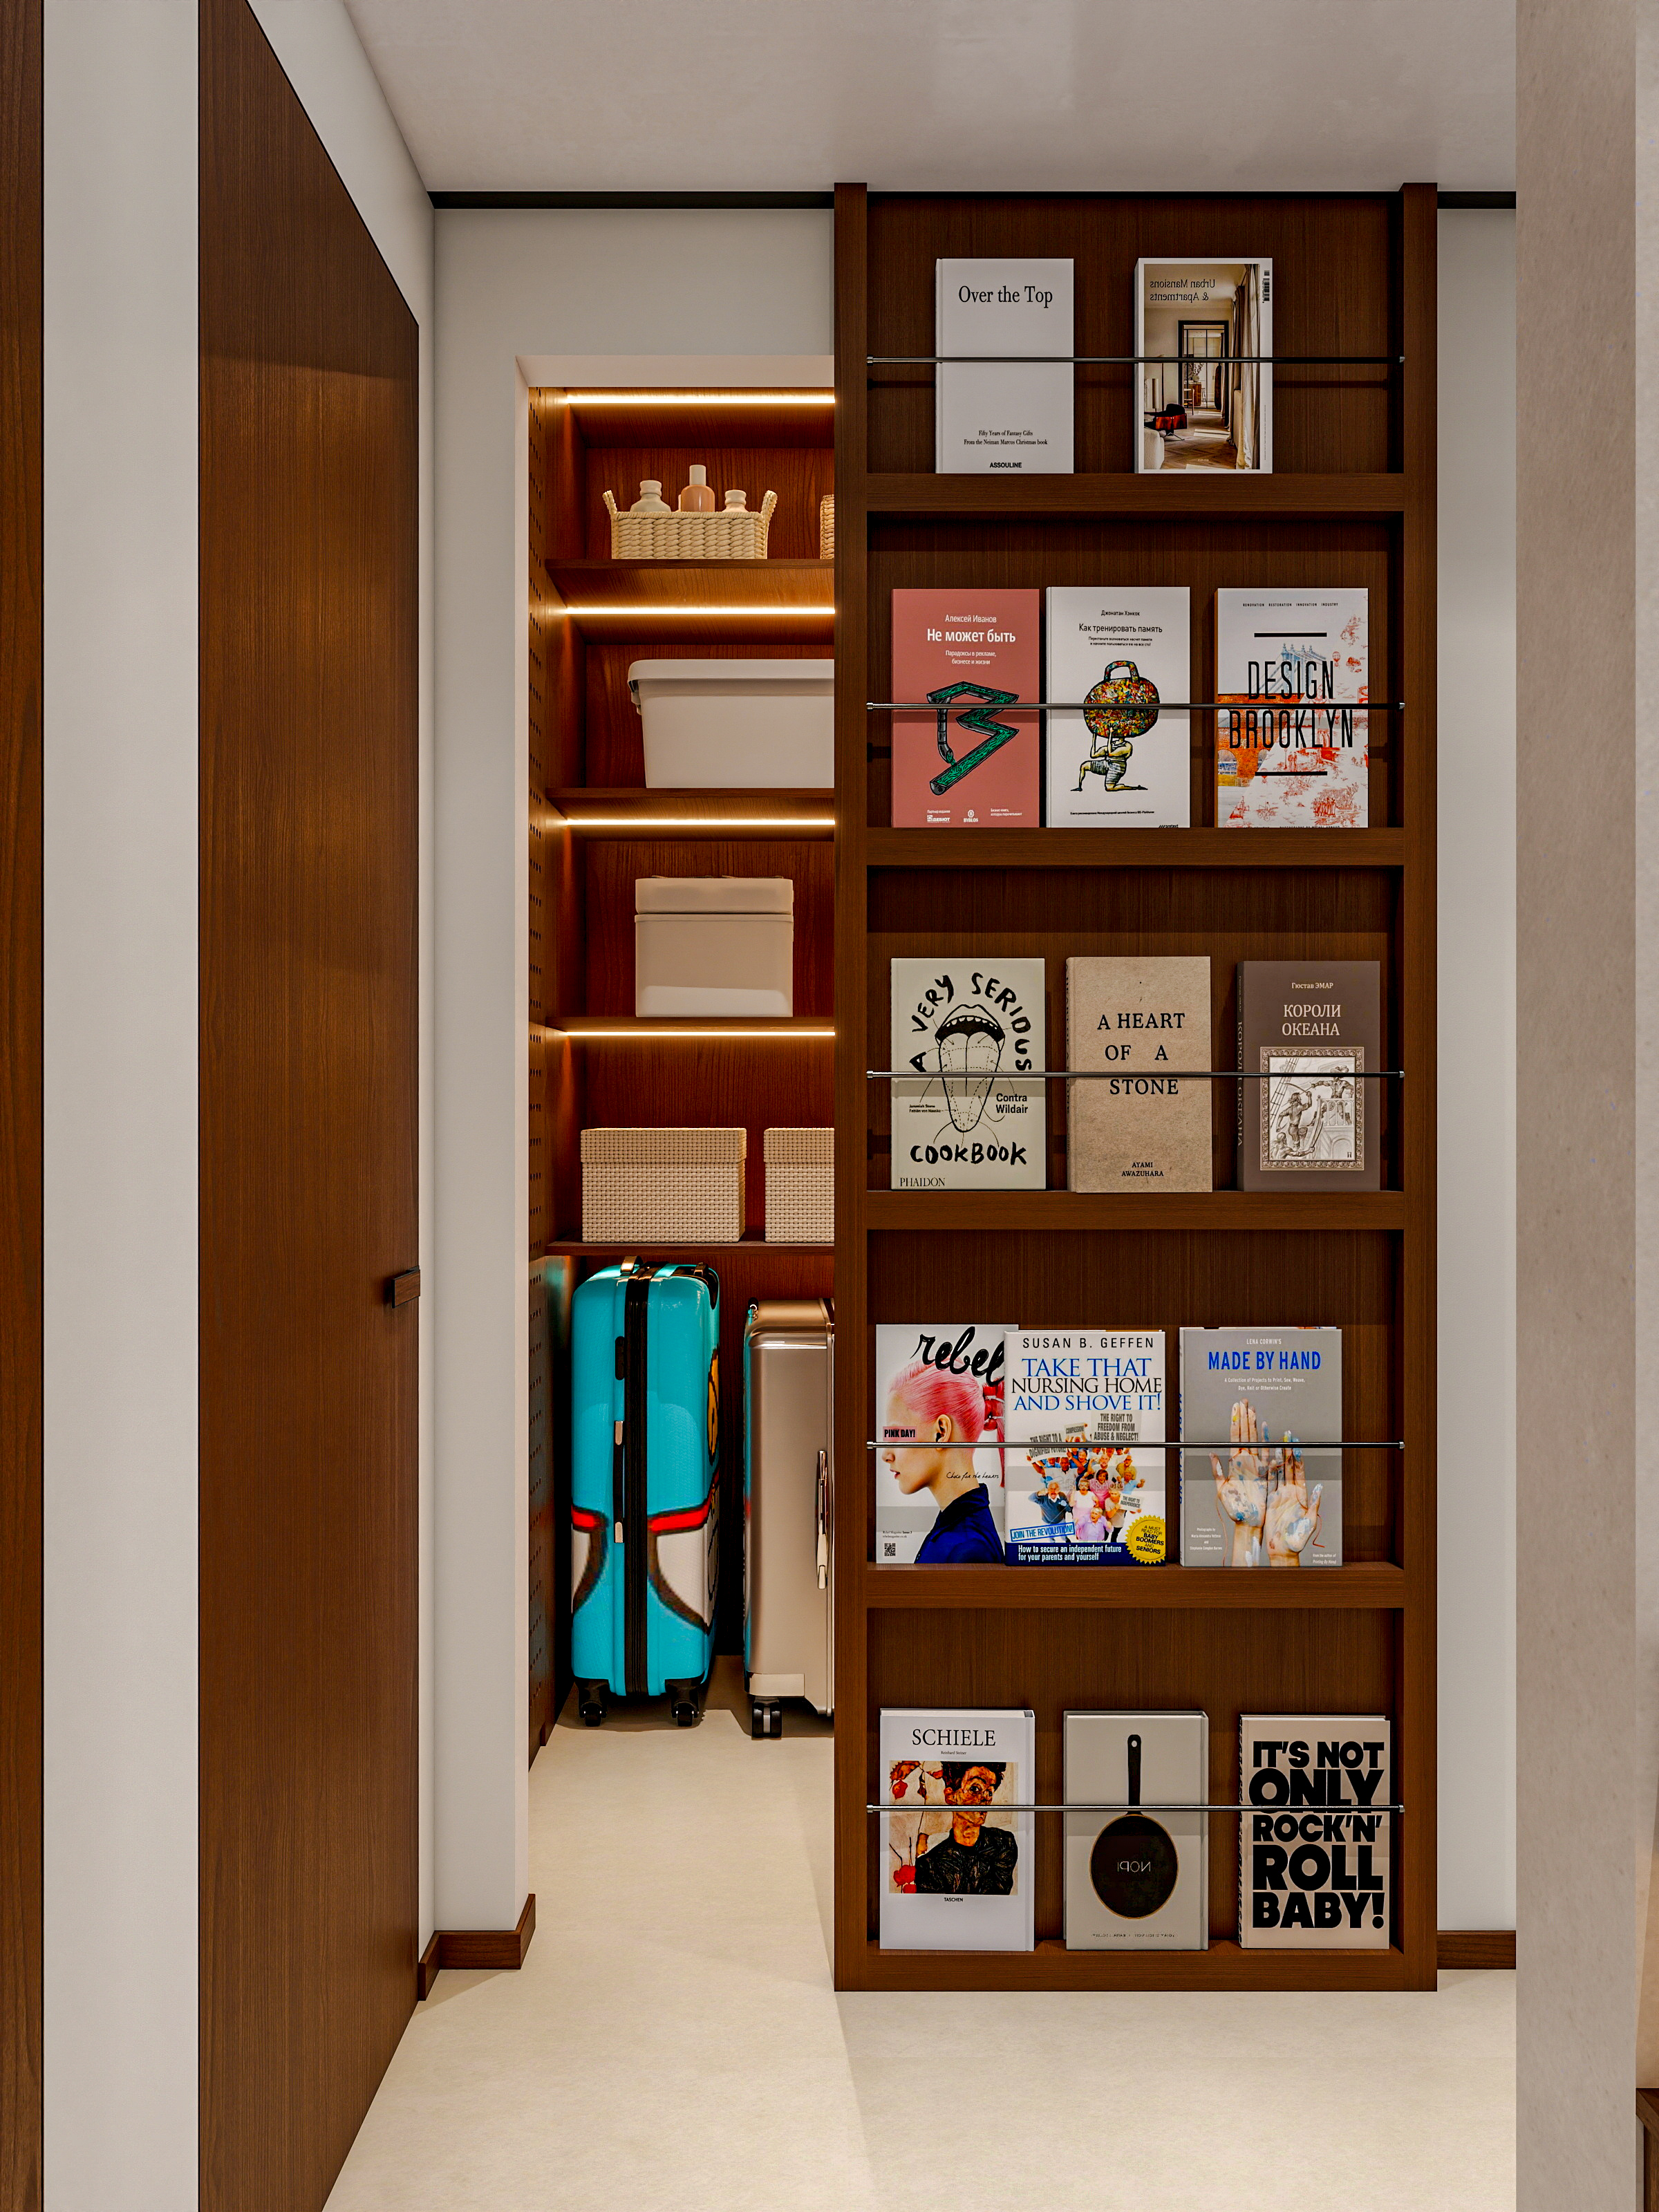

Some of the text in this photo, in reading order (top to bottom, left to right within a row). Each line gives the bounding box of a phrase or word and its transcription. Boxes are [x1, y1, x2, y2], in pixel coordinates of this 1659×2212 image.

[959, 285, 1053, 308] Over the Top
[945, 614, 997, 623] Алексей Иванов
[927, 628, 1015, 642] Не может быть
[1079, 624, 1091, 632] Как
[1248, 661, 1333, 700] DESIGN
[1229, 710, 1353, 748] BROOKLYN
[1284, 1004, 1341, 1018] КОРОЛИ
[909, 973, 1032, 1072] A VERY SERIOUS
[1097, 1013, 1185, 1030] A HEART
[1282, 1022, 1340, 1036] ОКЕАНА
[1105, 1044, 1169, 1060] OF A
[1109, 1079, 1179, 1095] STONE
[996, 1093, 1027, 1102] Contra
[996, 1105, 1029, 1114] Wildair
[910, 1141, 1027, 1165] COOKBOOK
[900, 1177, 945, 1187] PHAIDON
[1022, 1338, 1154, 1348] SUSAN B. GEFFEN
[910, 1326, 1004, 1387] rebel
[1208, 1351, 1321, 1369] MADE BY HAND
[1021, 1358, 1152, 1377] TAKE THAT
[1011, 1378, 1162, 1394] NURSING HOME
[1013, 1393, 1161, 1411] AND SHOVE IT!
[1100, 1414, 1133, 1422] THE RIGHT TO
[884, 1429, 915, 1438] PINK DAY!
[1098, 1423, 1135, 1432] FREEDOM FROM
[1039, 1434, 1052, 1442] RIGHT
[1052, 1434, 1058, 1442] TO
[1058, 1433, 1062, 1442] A
[1094, 1432, 1138, 1441] ABUSE & NEGLECT!
[1012, 1524, 1074, 1539] JOIN THE REVOLUTION!
[1136, 1537, 1164, 1546] BOOMERS
[1069, 1545, 1103, 1555] independent
[1136, 1546, 1161, 1554] SENIORS
[1076, 1554, 1099, 1562] yourself
[912, 1729, 996, 1746] SCHIELE
[1253, 1741, 1385, 1769] IT'S NOT
[1248, 1768, 1385, 1814] ONLY
[1253, 1814, 1382, 1842] ROCK'N'
[1253, 1844, 1383, 1891] ROLL
[1253, 1892, 1385, 1929] BABY!
